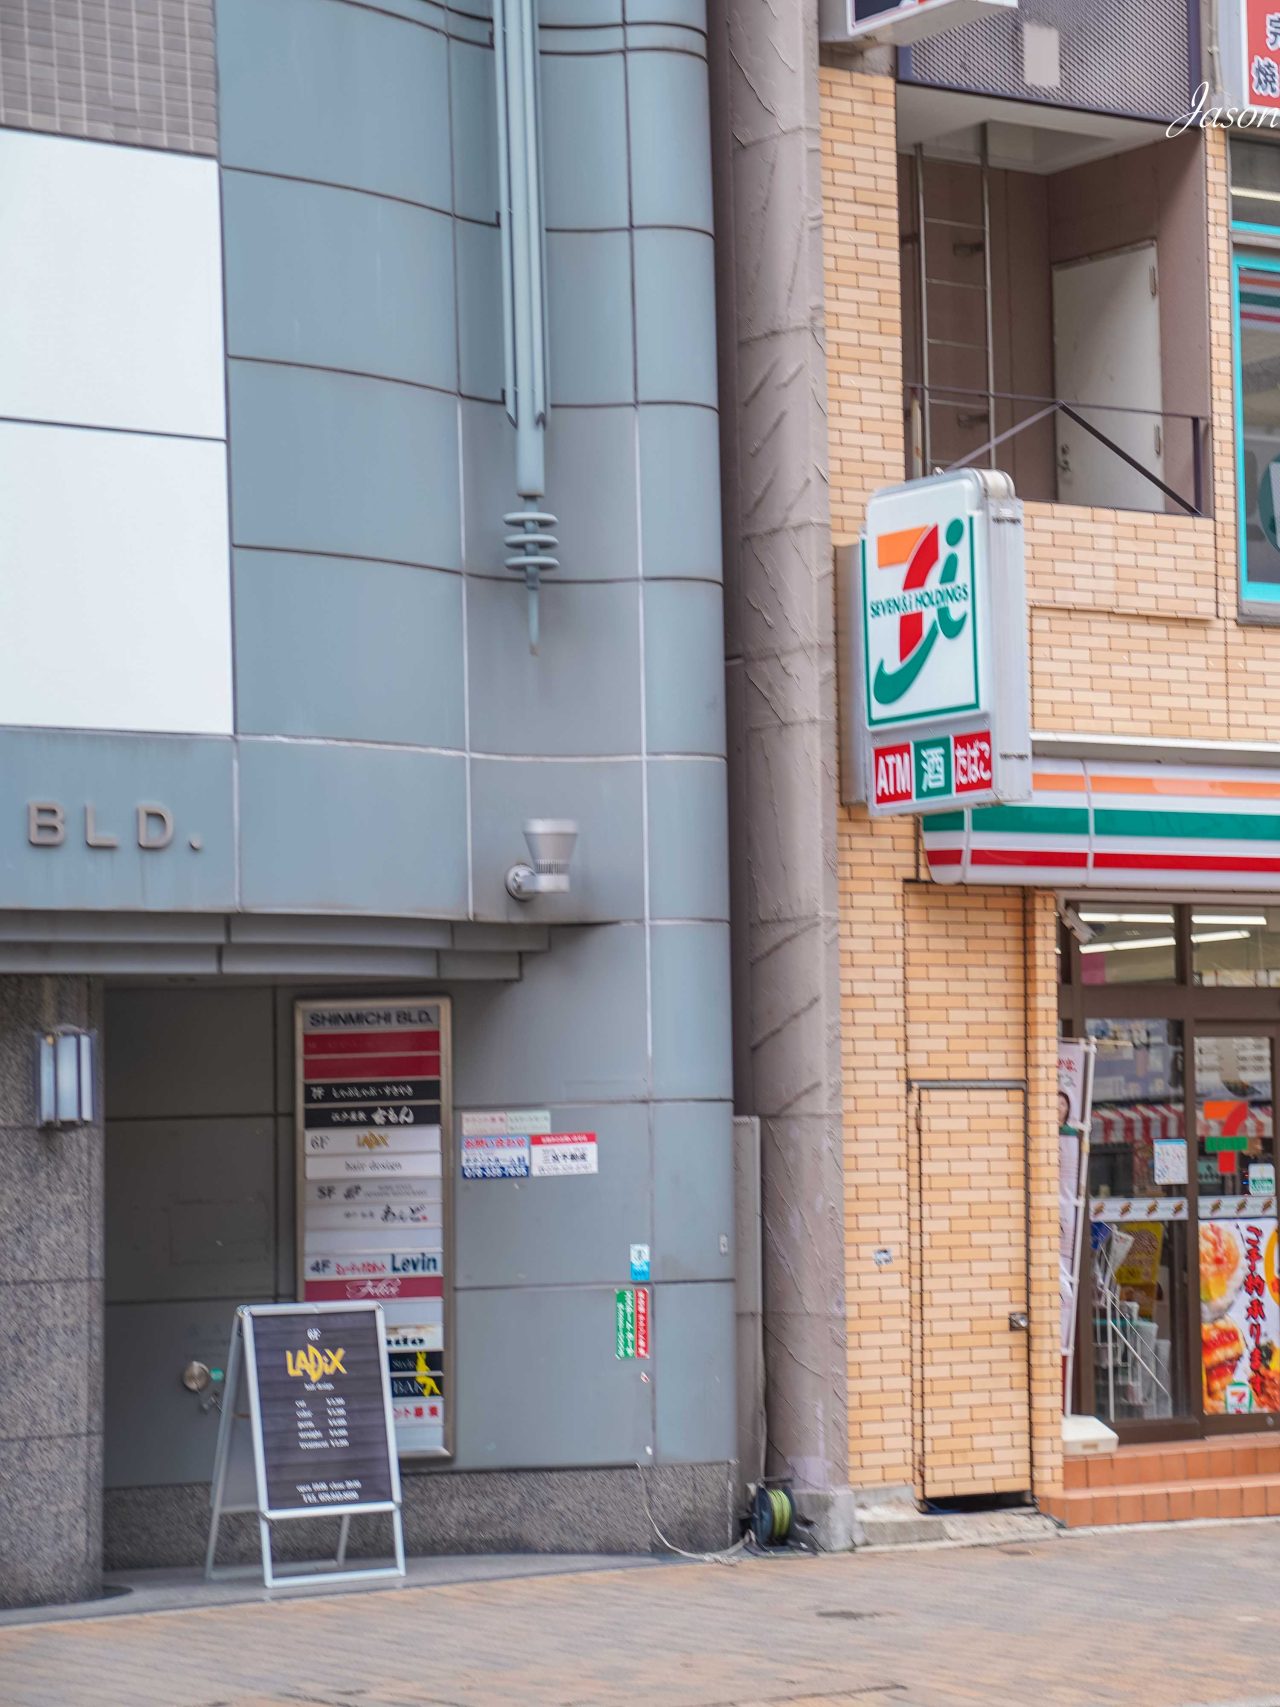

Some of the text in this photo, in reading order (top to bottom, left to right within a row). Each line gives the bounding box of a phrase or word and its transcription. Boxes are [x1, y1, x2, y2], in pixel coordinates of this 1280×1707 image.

[914, 583, 969, 609] HOLDINGS
[878, 754, 911, 796] ATM
[920, 746, 946, 793] 酒
[954, 742, 993, 785] たばこ
[27, 802, 204, 851] BLD.
[309, 1011, 393, 1027] SHINMICHI
[390, 1252, 438, 1273] Levin
